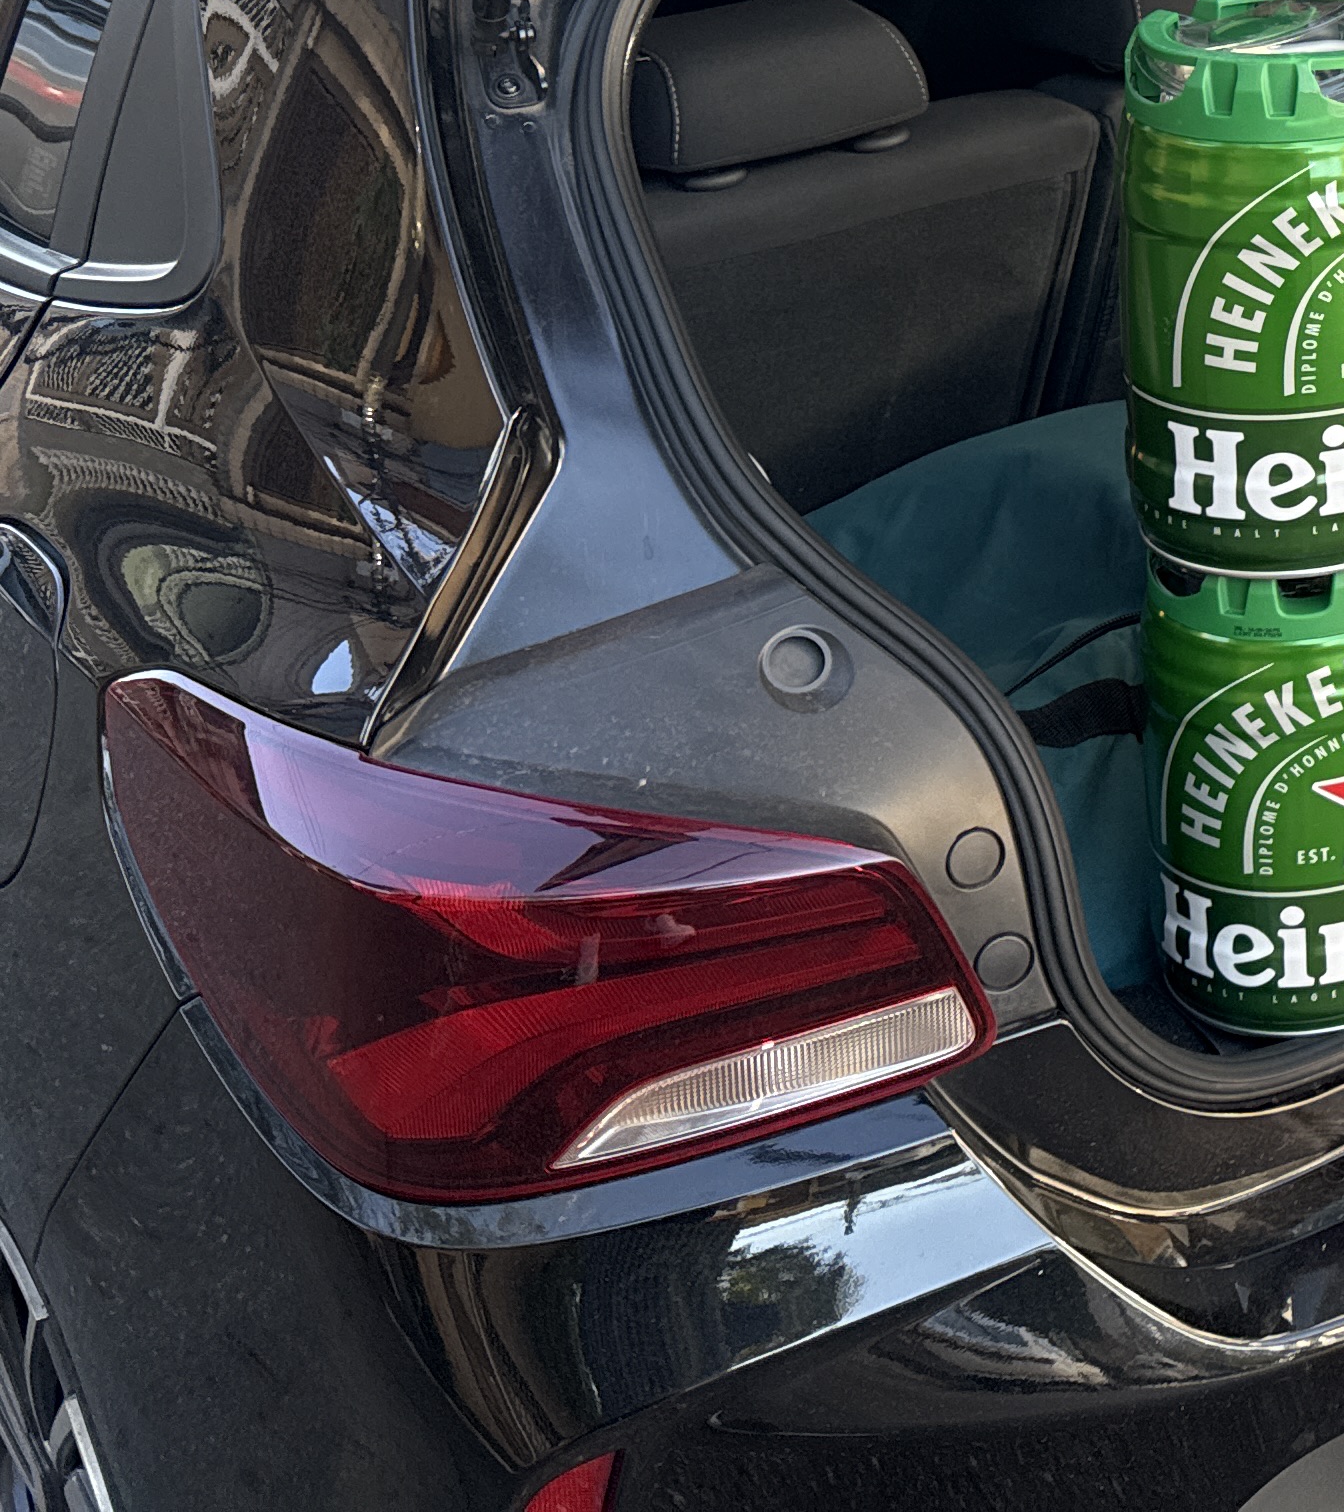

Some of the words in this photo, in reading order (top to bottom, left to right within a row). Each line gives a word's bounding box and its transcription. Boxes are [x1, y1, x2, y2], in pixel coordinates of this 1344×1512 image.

[1301, 311, 1325, 395] DIPLOME
[1213, 526, 1281, 539] MALT
[1258, 796, 1281, 876] DIPLOME
[1297, 846, 1336, 866] EST.
